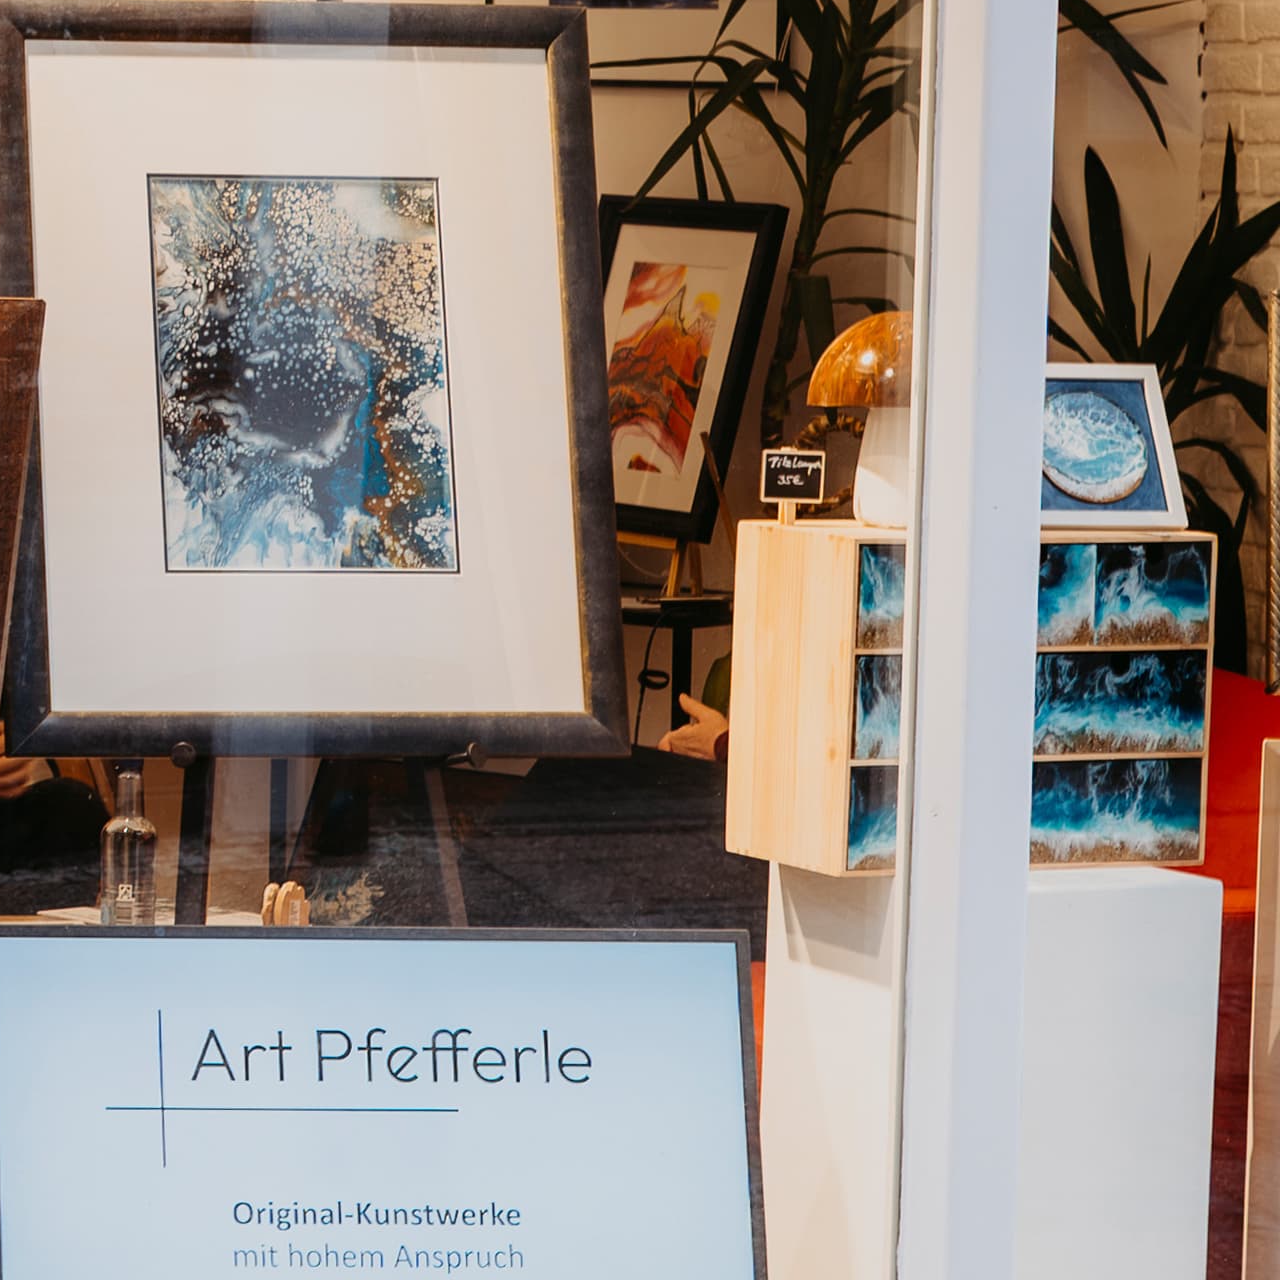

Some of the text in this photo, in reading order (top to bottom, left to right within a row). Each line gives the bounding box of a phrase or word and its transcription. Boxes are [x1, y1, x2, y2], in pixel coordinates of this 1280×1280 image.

[191, 1027, 592, 1084] Art Pfefferle
[232, 1201, 522, 1232] Original-Kunstwerke
[233, 1243, 524, 1274] mit hohem Anspruch
